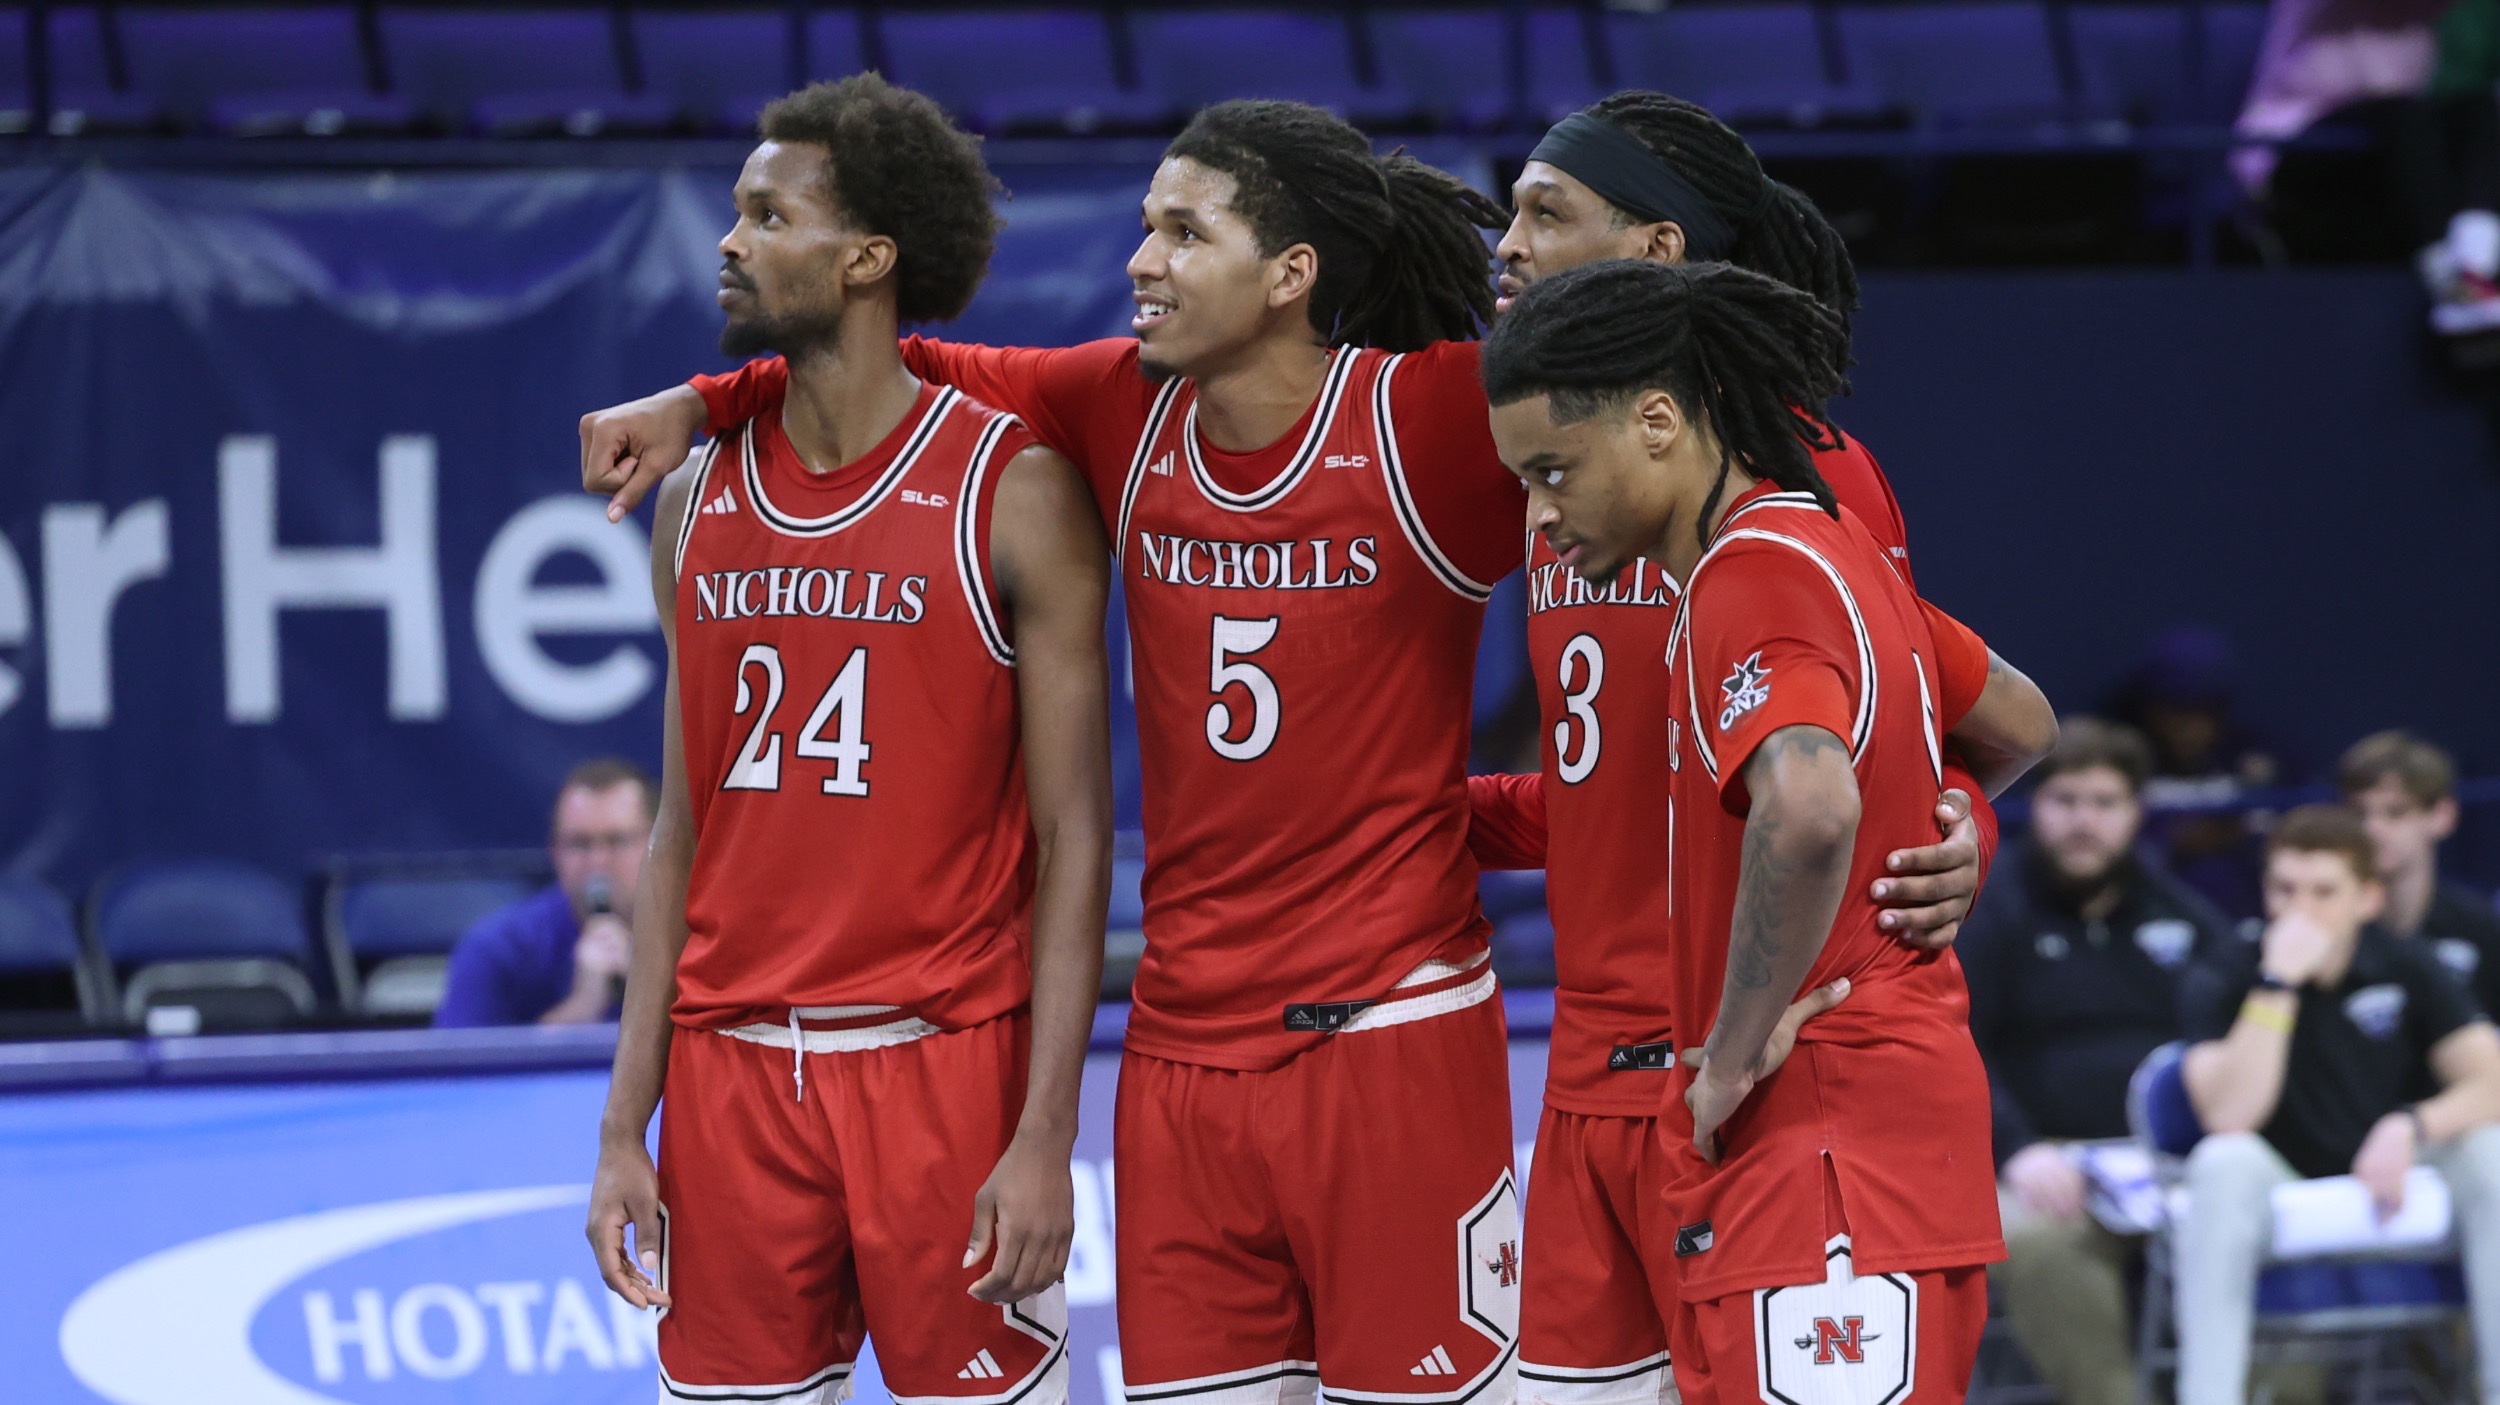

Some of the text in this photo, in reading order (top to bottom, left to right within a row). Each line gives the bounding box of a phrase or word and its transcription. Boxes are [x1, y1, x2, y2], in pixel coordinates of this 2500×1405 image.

[1324, 454, 1370, 469] SLC
[900, 489, 950, 508] SLC
[1139, 531, 1379, 590] NICHOLLS
[694, 565, 928, 625] NICHOLLS
[1206, 613, 1281, 760] 5
[1553, 632, 1605, 785] 3
[1719, 683, 1770, 731] ONE
[718, 643, 872, 798] 24
[1329, 1014, 1338, 1025] M
[1813, 1315, 1864, 1365] N
